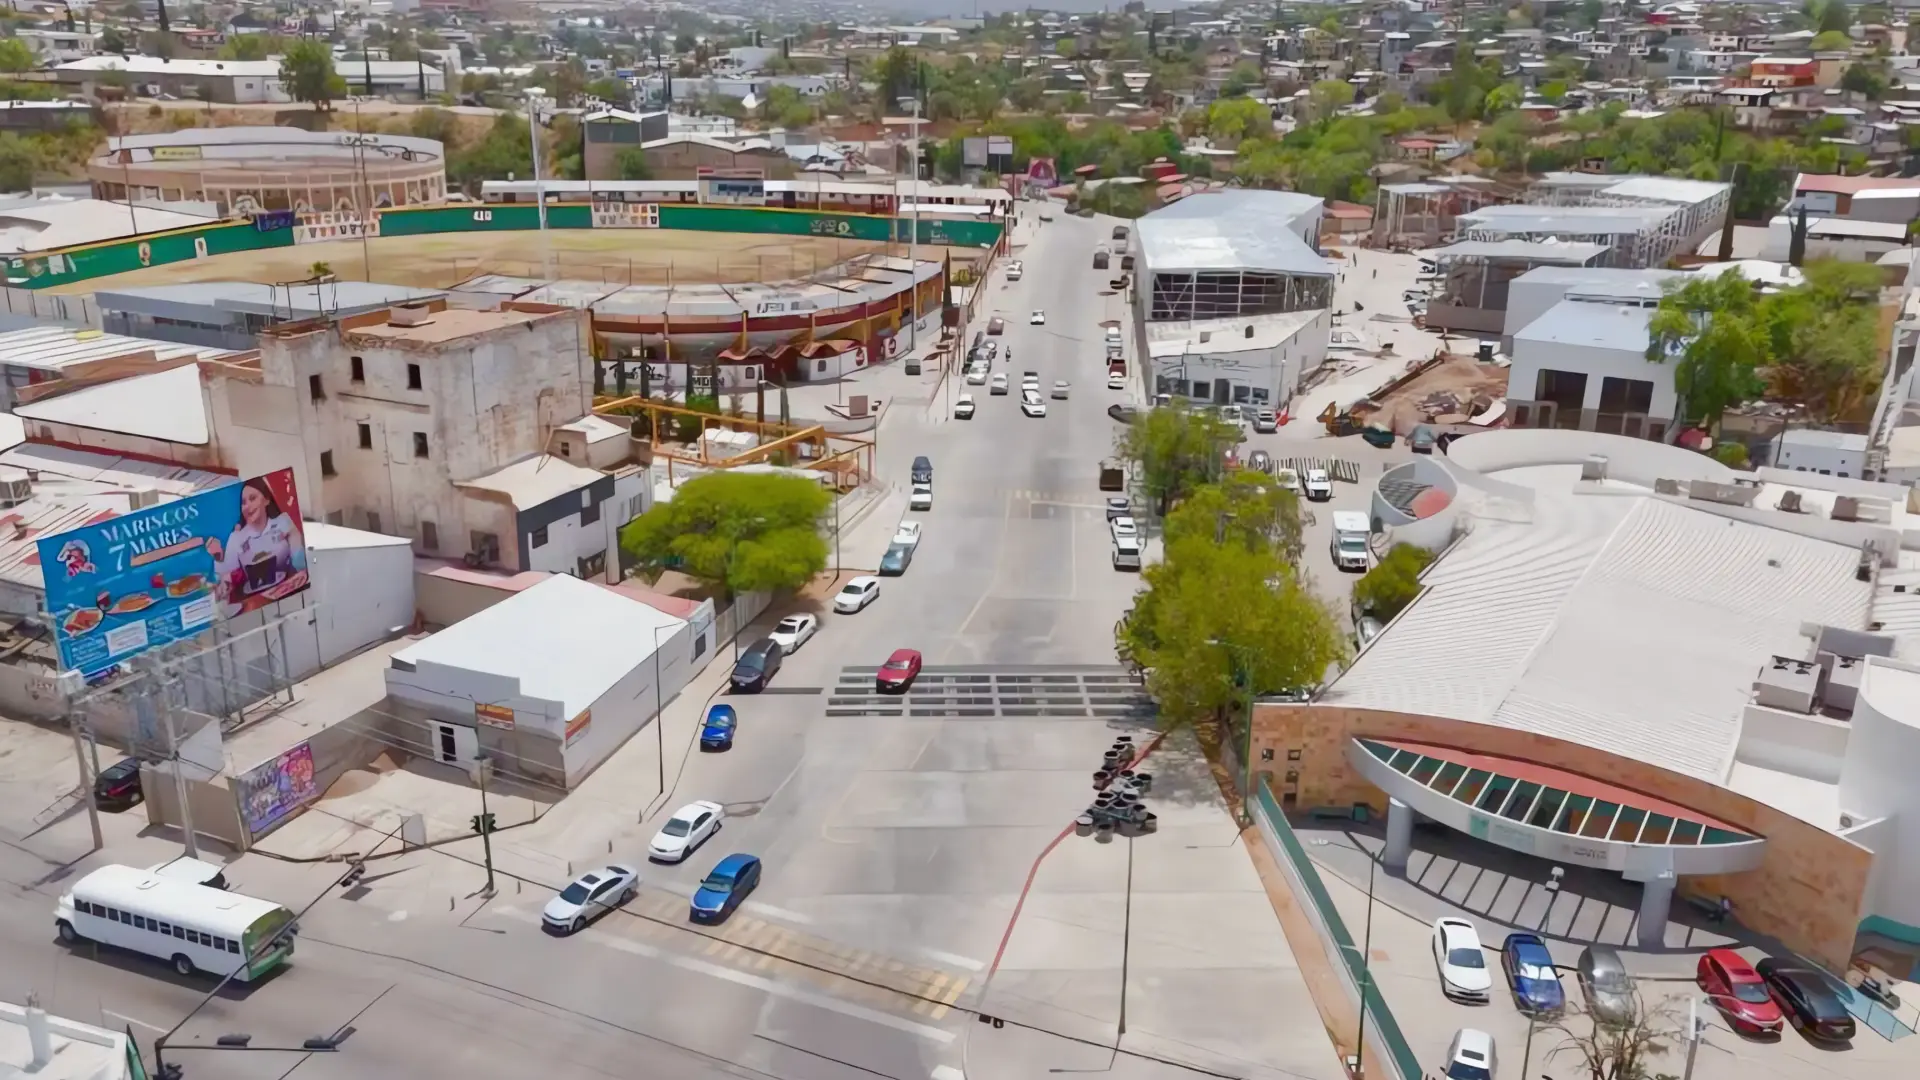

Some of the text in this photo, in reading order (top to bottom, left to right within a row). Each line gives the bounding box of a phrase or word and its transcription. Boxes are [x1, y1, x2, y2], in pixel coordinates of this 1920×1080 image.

[100, 503, 199, 542] MARISCOS
[108, 524, 193, 572] 7 MARES
